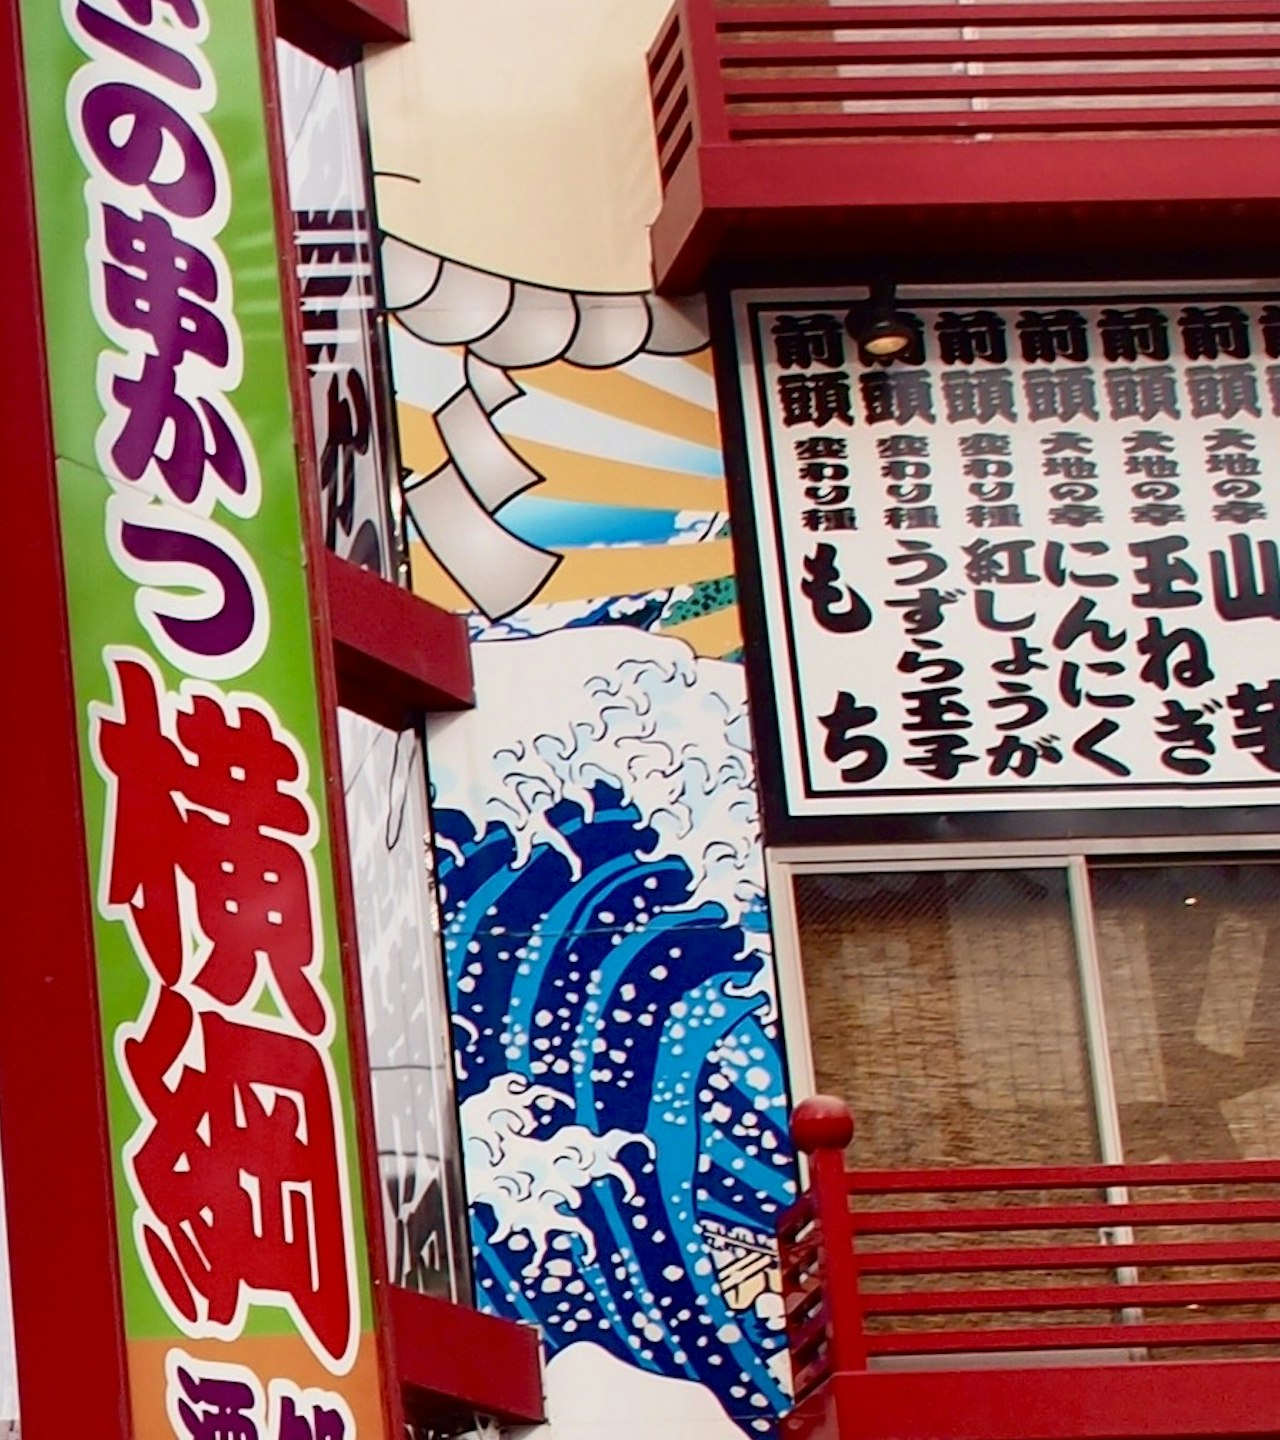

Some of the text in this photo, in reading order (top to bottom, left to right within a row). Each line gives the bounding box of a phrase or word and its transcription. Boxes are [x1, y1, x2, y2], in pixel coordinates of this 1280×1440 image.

[801, 543, 887, 782] もち
[886, 540, 976, 779] うずら玉子
[961, 539, 1062, 778] 紅しょうが
[1044, 540, 1134, 776] にんにく
[101, 659, 358, 1361] 横綱
